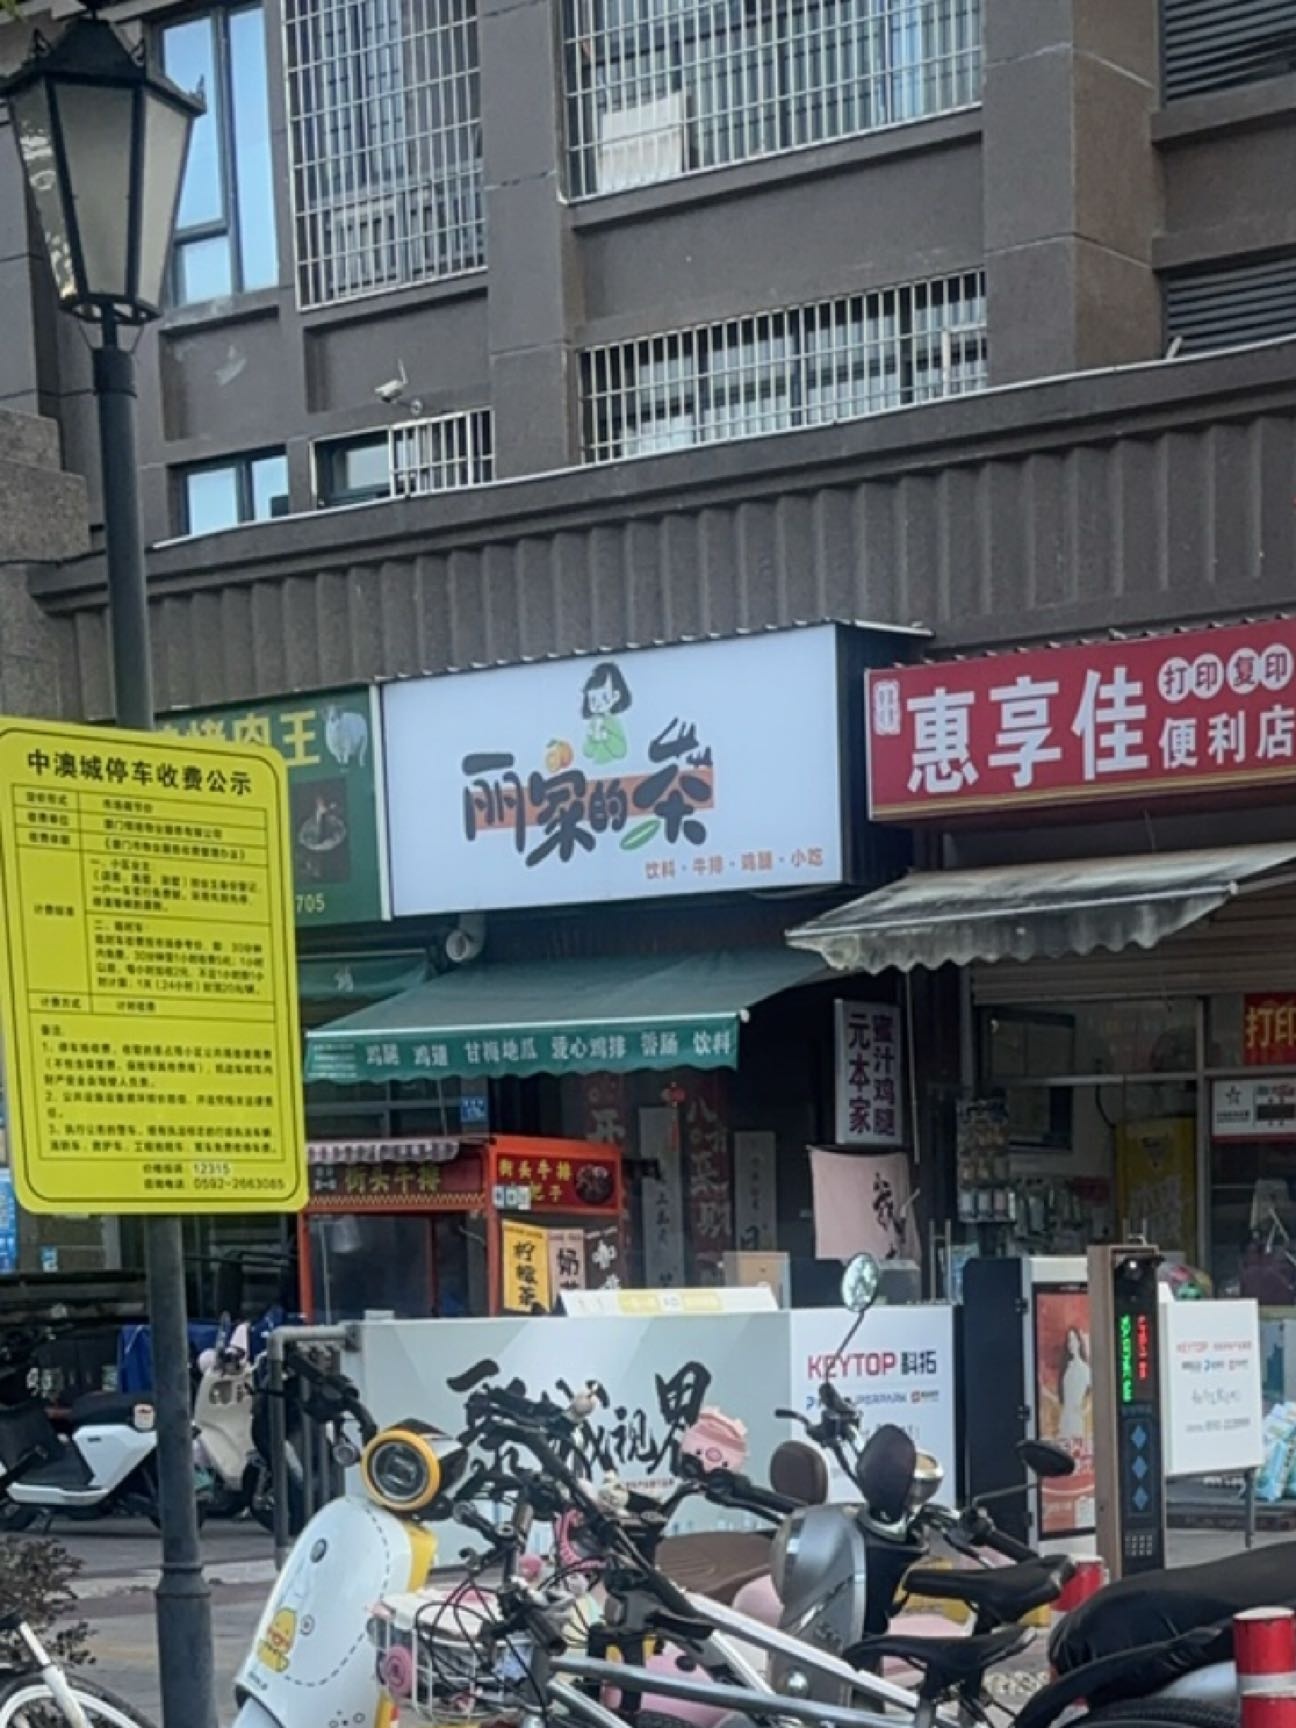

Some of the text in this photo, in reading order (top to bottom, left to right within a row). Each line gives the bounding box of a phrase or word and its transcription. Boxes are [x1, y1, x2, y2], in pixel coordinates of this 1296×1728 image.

[1160, 645, 1294, 703] 打印复印
[906, 666, 1149, 794] 惠享佳
[1159, 705, 1296, 770] 便利店
[27, 748, 252, 796] 中澳城停车收费公示
[462, 717, 714, 867] 丽家的茶
[848, 1013, 871, 1135] 元本家
[194, 1162, 231, 1175] 12315
[807, 1352, 897, 1380] KEYTOP
